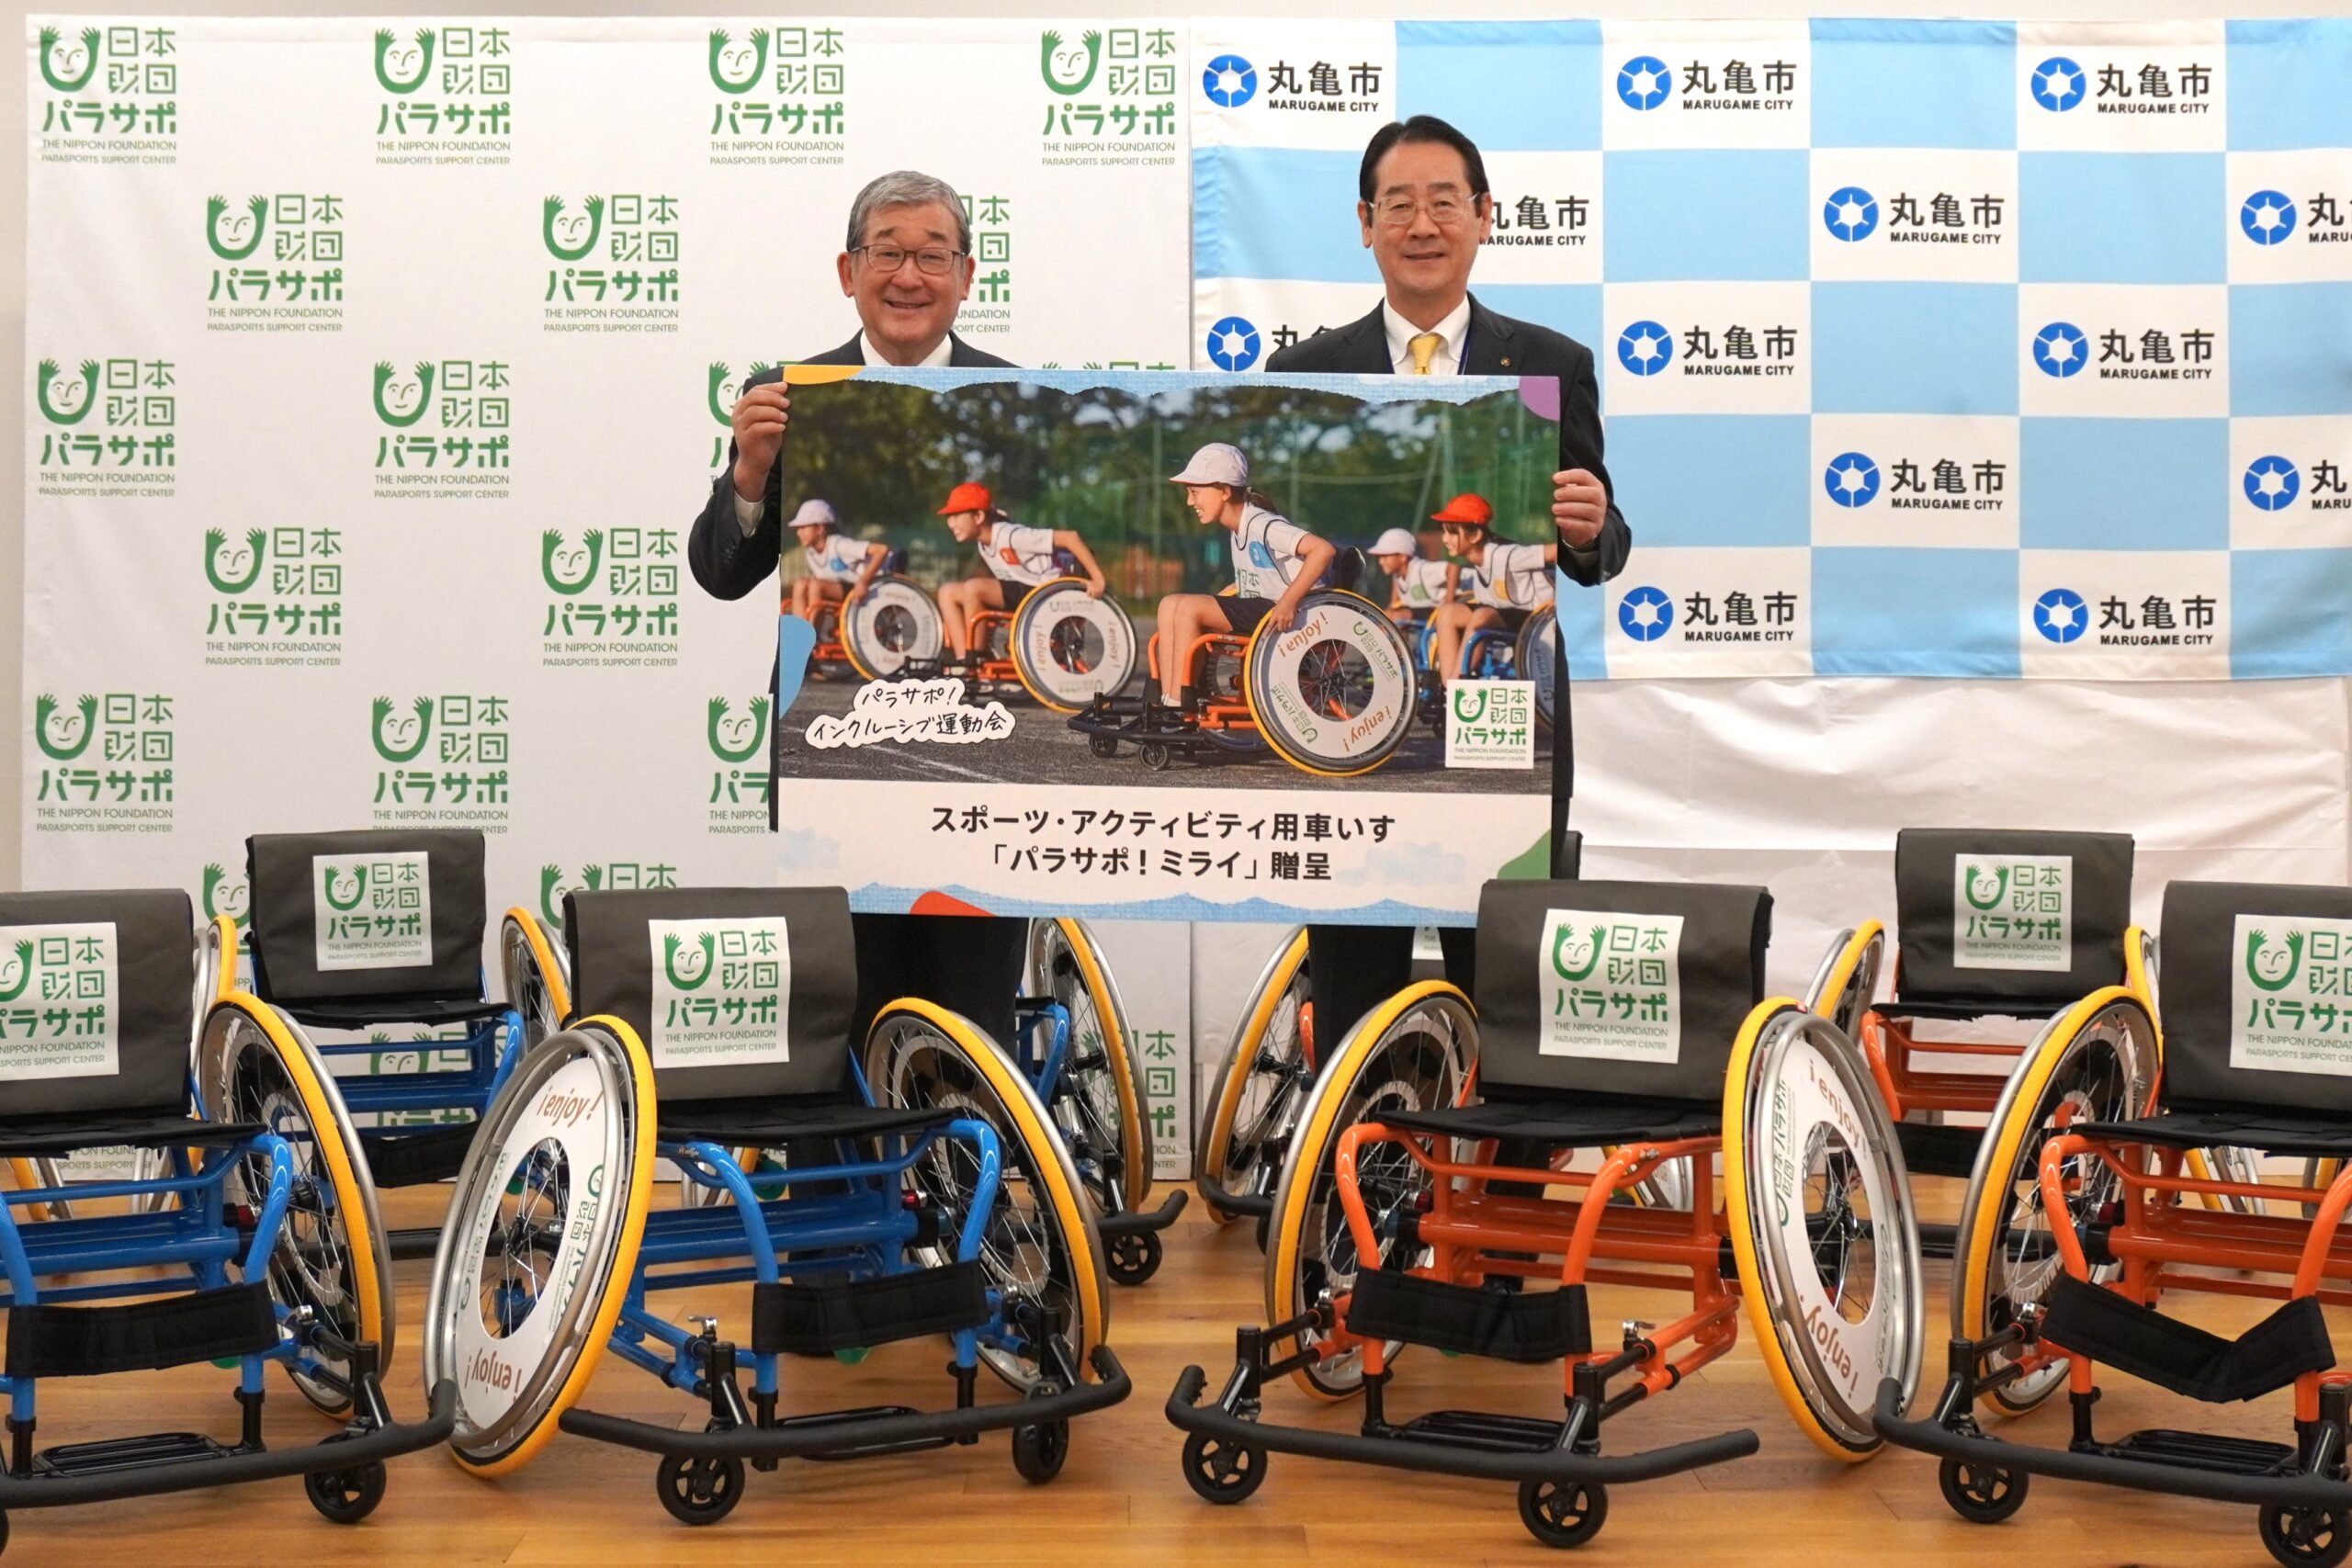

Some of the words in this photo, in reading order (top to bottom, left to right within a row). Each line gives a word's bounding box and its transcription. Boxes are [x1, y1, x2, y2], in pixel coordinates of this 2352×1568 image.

[108, 27, 175, 57] 日本
[443, 28, 510, 58] 日本
[776, 28, 843, 57] 日本
[1109, 28, 1176, 59] 日本
[108, 63, 175, 95] 財団
[443, 64, 510, 95] 財団
[776, 64, 843, 95] 財団
[1109, 65, 1175, 96] 財団
[1268, 62, 1382, 96] 丸亀市
[1682, 60, 1795, 94] 丸亀市
[2098, 64, 2211, 97] 丸亀市
[42, 99, 175, 134] パラサポ
[377, 101, 510, 134] パラサポ
[711, 101, 843, 134] パラサポ
[1043, 101, 1175, 136] パラサポ
[1270, 100, 1344, 111] MARUGAME
[1351, 103, 1377, 111] CITY
[1684, 100, 1759, 109] MARUGAME
[1765, 101, 1792, 109] CITY
[2098, 104, 2174, 113] MARUGAME
[2181, 104, 2208, 112] CITY
[376, 156, 433, 164] PARASPORTS
[435, 156, 474, 164] SUPPORT
[477, 156, 510, 164] CENTER
[377, 141, 394, 151] THE
[399, 141, 438, 151] NIPPON
[442, 141, 510, 151] FOUNDATION
[1041, 157, 1097, 166] PARASPORTS
[1101, 157, 1138, 165] SUPPORT
[1141, 156, 1174, 165] CENTER
[1043, 142, 1060, 152] THE
[1064, 142, 1103, 152] NIPPON
[1107, 141, 1174, 152] FOUNDATION
[276, 194, 343, 224] 日本
[611, 195, 678, 225] 日本
[1890, 193, 2004, 228] 丸亀市
[275, 231, 343, 261] 財団
[611, 231, 678, 262] 財団
[1558, 236, 1585, 245] CITY
[1891, 233, 1967, 243] MARUGAME
[1973, 234, 2000, 243] CITY
[2309, 232, 2352, 243] MARU
[208, 267, 343, 300] パラサポ
[545, 268, 678, 301] パラサポ
[1683, 325, 1796, 359] 丸亀市
[2099, 329, 2214, 363] 丸亀市
[107, 359, 175, 389] 日本
[442, 361, 509, 390] 日本
[1685, 366, 1760, 375] MARUGAME
[1766, 367, 1793, 375] CITY
[2101, 369, 2177, 378] MARUGAME
[2183, 369, 2211, 378] CITY
[107, 396, 175, 426] 財団
[442, 398, 509, 428] 財団
[40, 432, 175, 466] パラサポ
[375, 434, 509, 468] パラサポ
[1891, 458, 2006, 494] 丸亀市
[1892, 499, 1969, 509] MARUGAME
[1974, 501, 2002, 509] CITY
[2312, 499, 2352, 509] MARU
[274, 527, 342, 558] 日本
[610, 528, 678, 558] 日本
[273, 564, 341, 595] 財団
[610, 565, 677, 595] 財団
[206, 601, 341, 635] パラサポ
[544, 602, 677, 636] パラサポ
[1684, 592, 1797, 626] 丸亀市
[2099, 595, 2216, 629] 丸亀市
[206, 642, 224, 651] THE
[228, 642, 268, 651] NIPPON
[272, 642, 340, 651] FOUNDATION
[544, 643, 561, 652] THE
[566, 643, 605, 652] NIPPON
[609, 643, 677, 652] FOUNDATION
[1685, 632, 1760, 641] MARUGAME
[1766, 631, 1792, 640] CITY
[2101, 636, 2179, 645] MARUGAME
[2185, 635, 2212, 645] CITY
[205, 657, 262, 665] PARASPORTS
[266, 657, 303, 665] SUPPORT
[306, 657, 340, 666] CENTER
[105, 694, 173, 724] 日本
[441, 695, 508, 726] 日本
[1491, 688, 1527, 704] 日本
[814, 710, 1007, 739] インクルーシブ運動会
[1455, 727, 1526, 745] パラサポ
[105, 730, 173, 761] 財団
[440, 733, 508, 763] 財団
[38, 767, 173, 802] パラサポ
[373, 770, 508, 803] パラサポ
[708, 825, 764, 833] PARASPORTS
[932, 805, 1396, 843] スポーツ・アクティビティ用車いす
[372, 863, 420, 884] 日本
[2013, 865, 2062, 886] 日本
[328, 913, 422, 939] パラサポ
[1610, 925, 1668, 953] 日本
[1967, 915, 2062, 940] パラサポ
[40, 936, 104, 966] 日本
[720, 930, 777, 956] 日本
[2311, 931, 2352, 960] 日
[2310, 965, 2352, 996] 財
[666, 994, 778, 1028] パラサポ
[1555, 987, 1668, 1022] パラサポ
[0, 1004, 105, 1039] ラサポ
[666, 1033, 681, 1043] THE
[684, 1032, 718, 1042] NIPPON
[720, 1030, 776, 1040] FOUNDATION
[1555, 1021, 1570, 1031] THE
[1573, 1023, 1608, 1032] NIPPON
[1610, 1026, 1668, 1037] FOUNDATION
[0, 1043, 38, 1054] NIPPON
[40, 1041, 105, 1053] FOUNDATION
[666, 1046, 713, 1055] PARASPORTS
[715, 1044, 746, 1053] SUPPORT
[749, 1043, 776, 1051] CENTER
[1555, 1036, 1601, 1045] PARASPORTS
[1604, 1039, 1635, 1047] SUPPORT
[1638, 1042, 1668, 1050] CENTER
[2245, 1048, 2299, 1059] PARASPORTS
[2301, 1052, 2337, 1061] SUPPORT
[2246, 1034, 2264, 1043] THE
[2267, 1036, 2305, 1046] NIPPON
[2308, 1038, 2352, 1049] FOUNDAT
[0, 1058, 32, 1067] SPORTS
[34, 1056, 71, 1066] SUPPORT
[74, 1054, 105, 1063] CENTER
